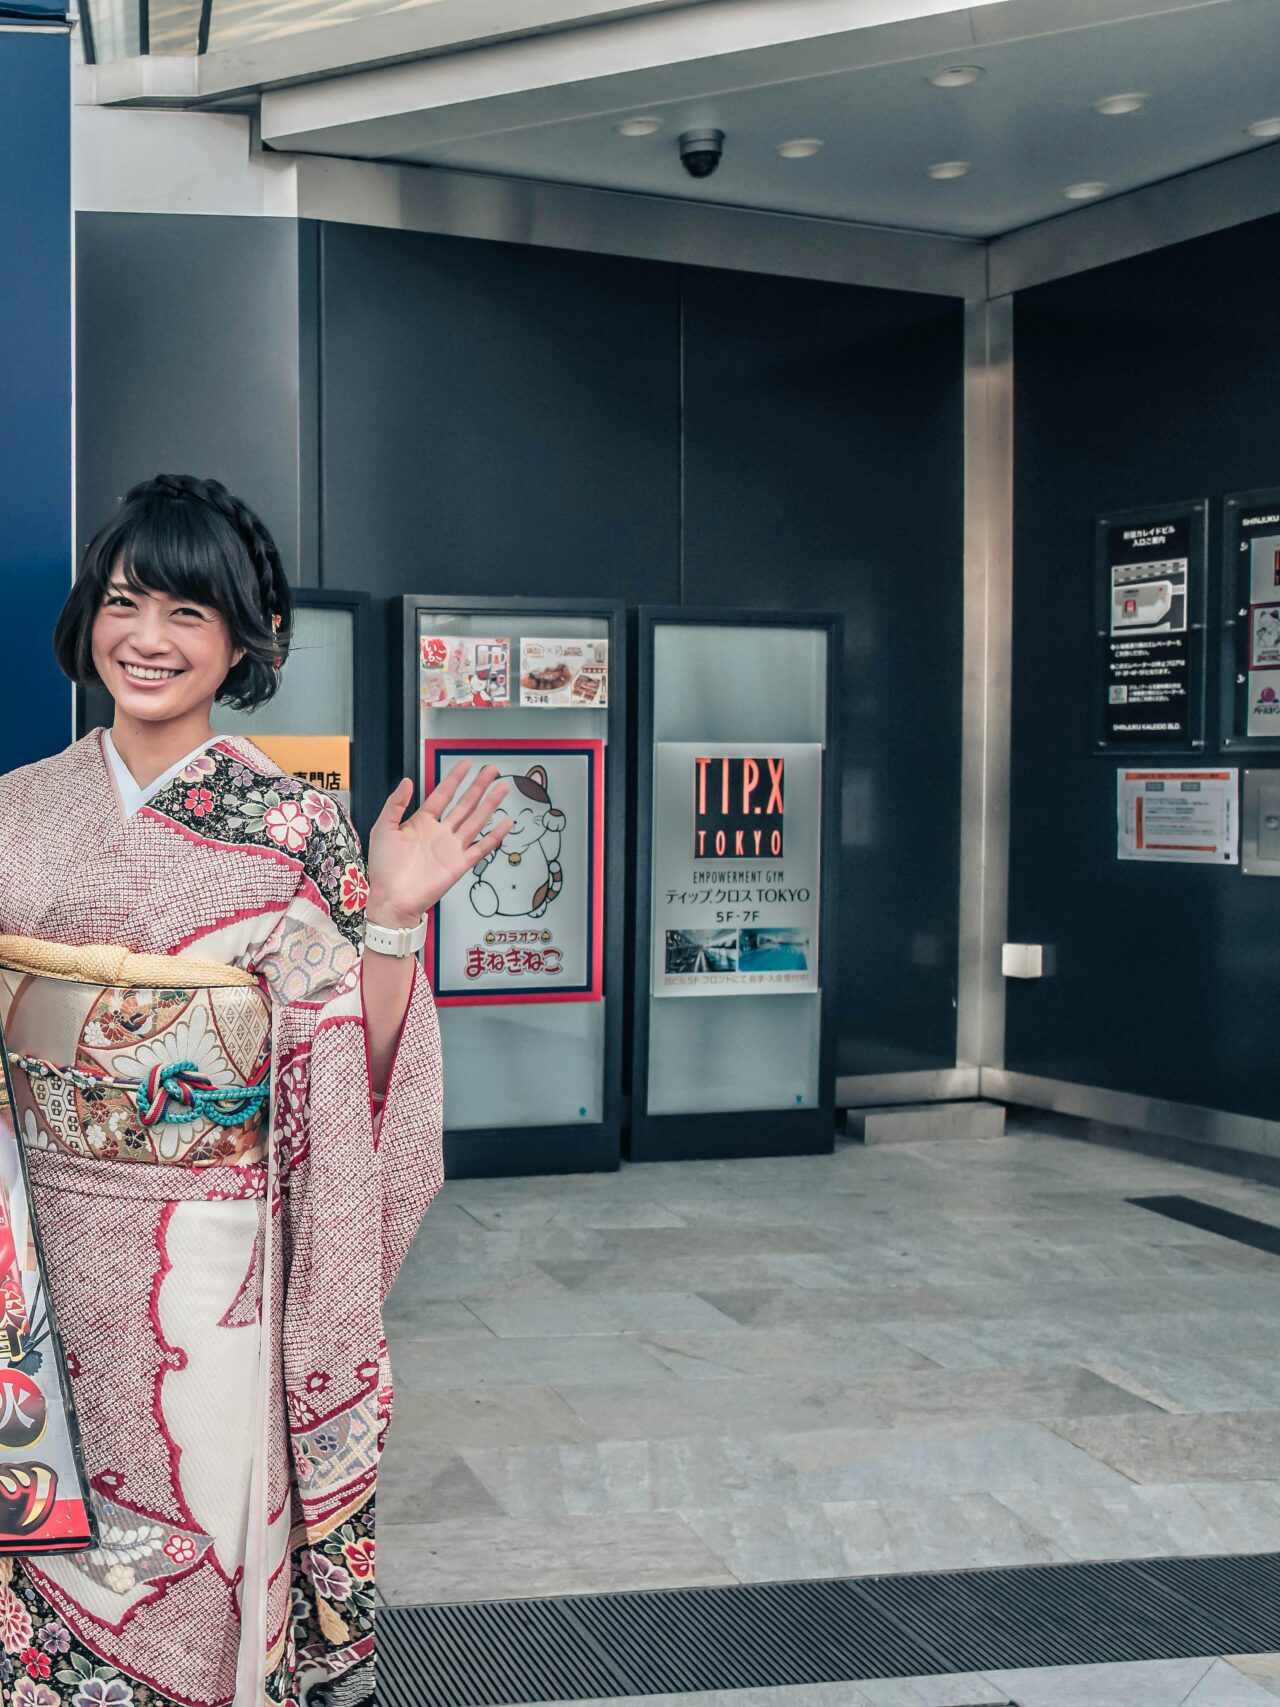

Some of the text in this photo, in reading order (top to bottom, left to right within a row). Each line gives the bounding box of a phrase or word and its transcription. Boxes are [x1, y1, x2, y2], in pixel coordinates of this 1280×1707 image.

[695, 757, 784, 815] TIP.X
[698, 830, 781, 856] TOKYO
[693, 870, 784, 884] EMPOWERMENT GYM
[757, 888, 810, 902] TOKYO
[465, 946, 562, 978] まねきねこ
